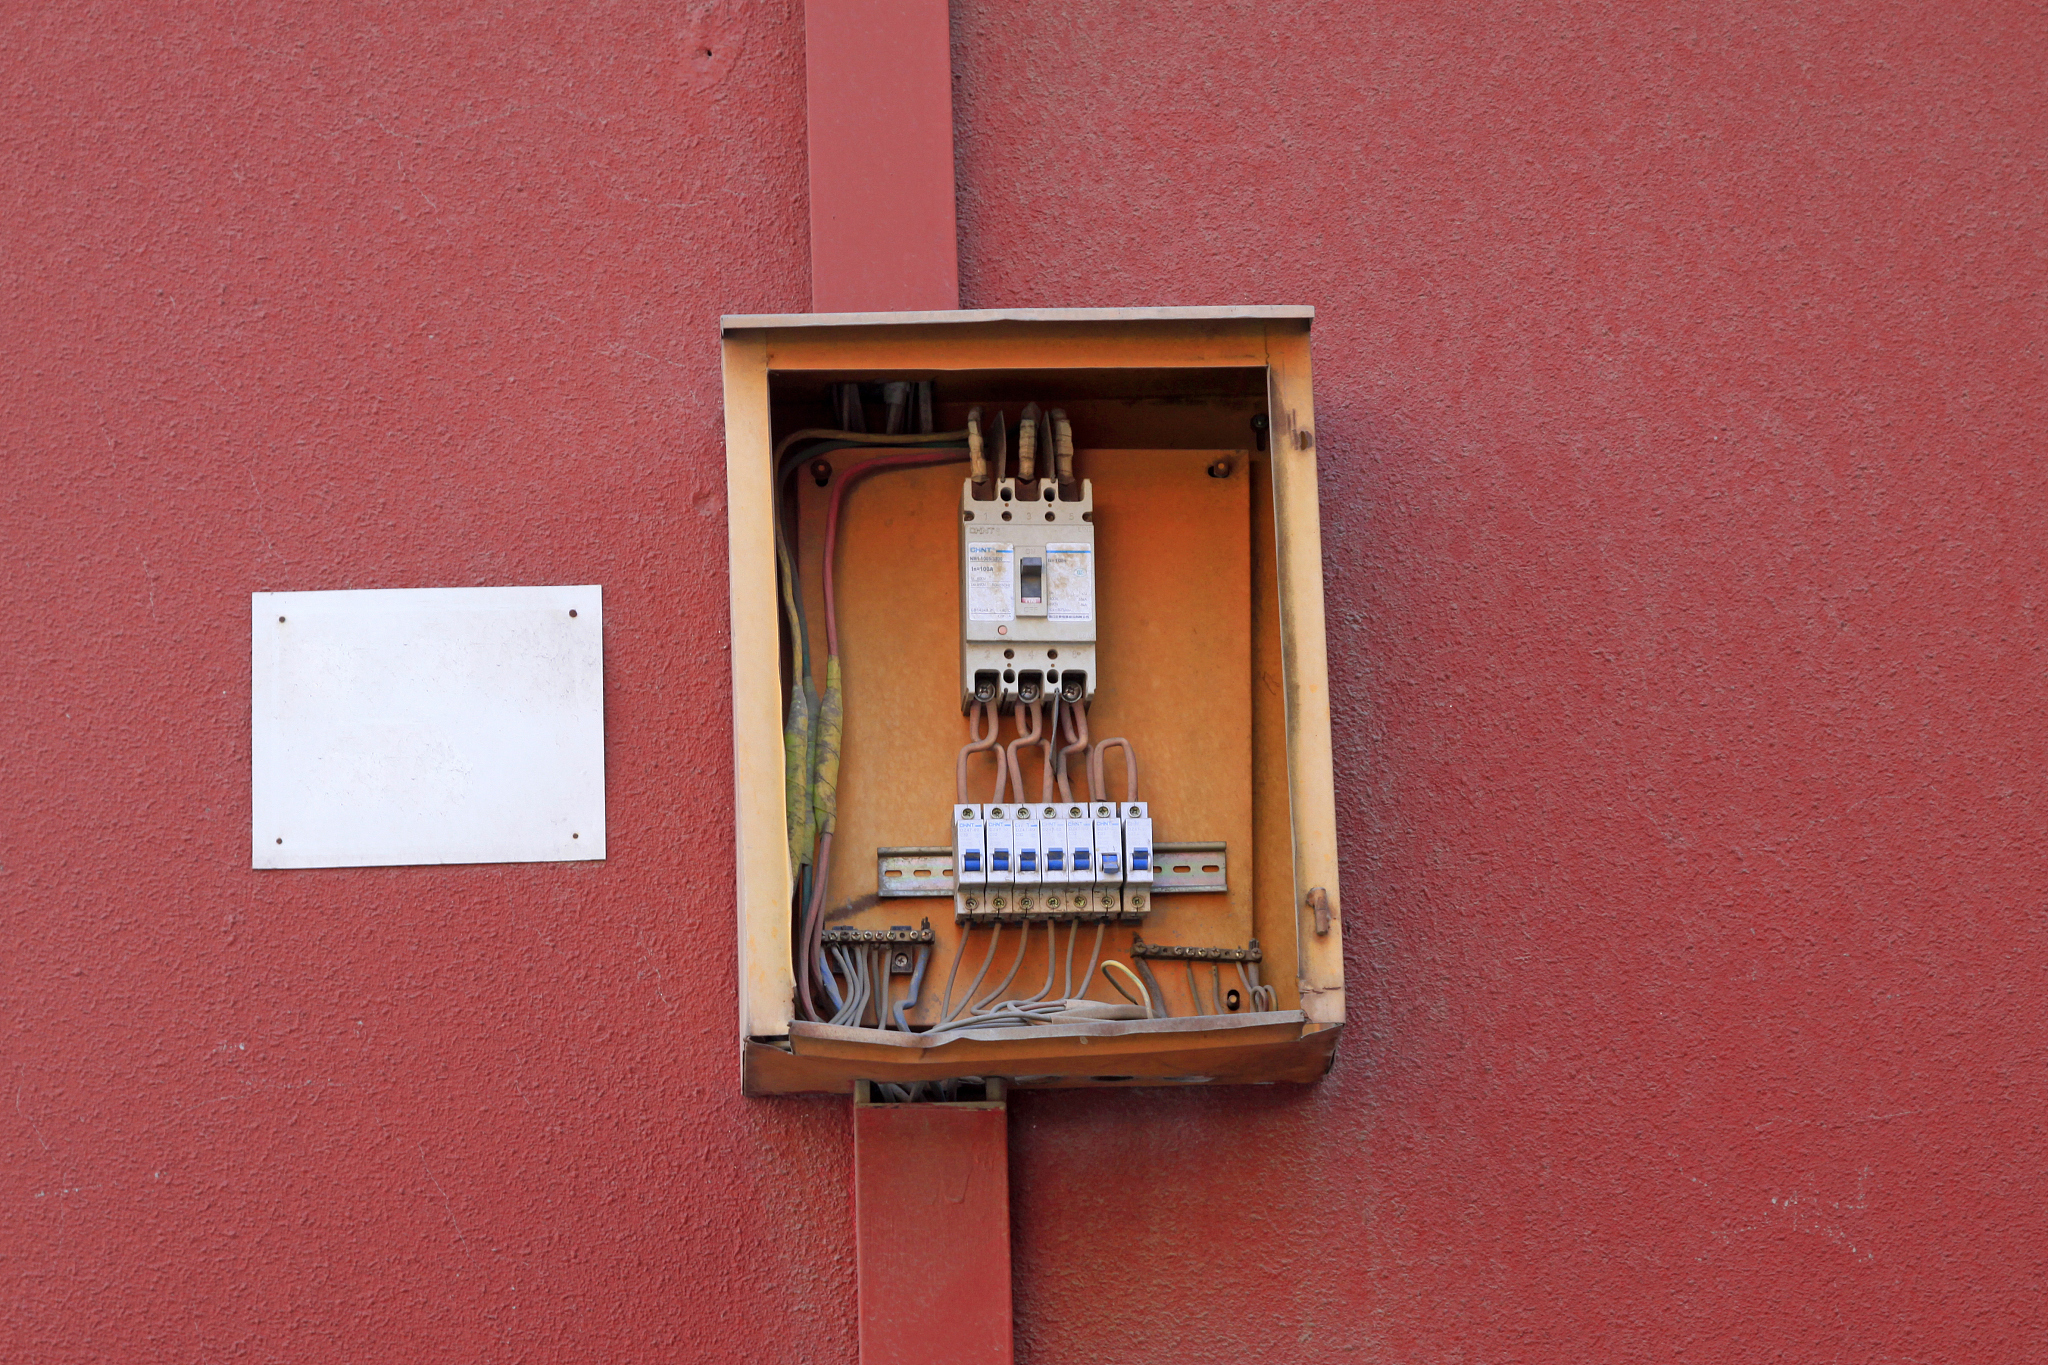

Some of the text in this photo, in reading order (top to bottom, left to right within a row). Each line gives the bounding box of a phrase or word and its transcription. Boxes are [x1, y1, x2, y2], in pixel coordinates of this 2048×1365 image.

[983, 512, 989, 521] 1
[1026, 512, 1032, 521] 3
[1068, 512, 1075, 521] 5
[1028, 650, 1034, 660] 4
